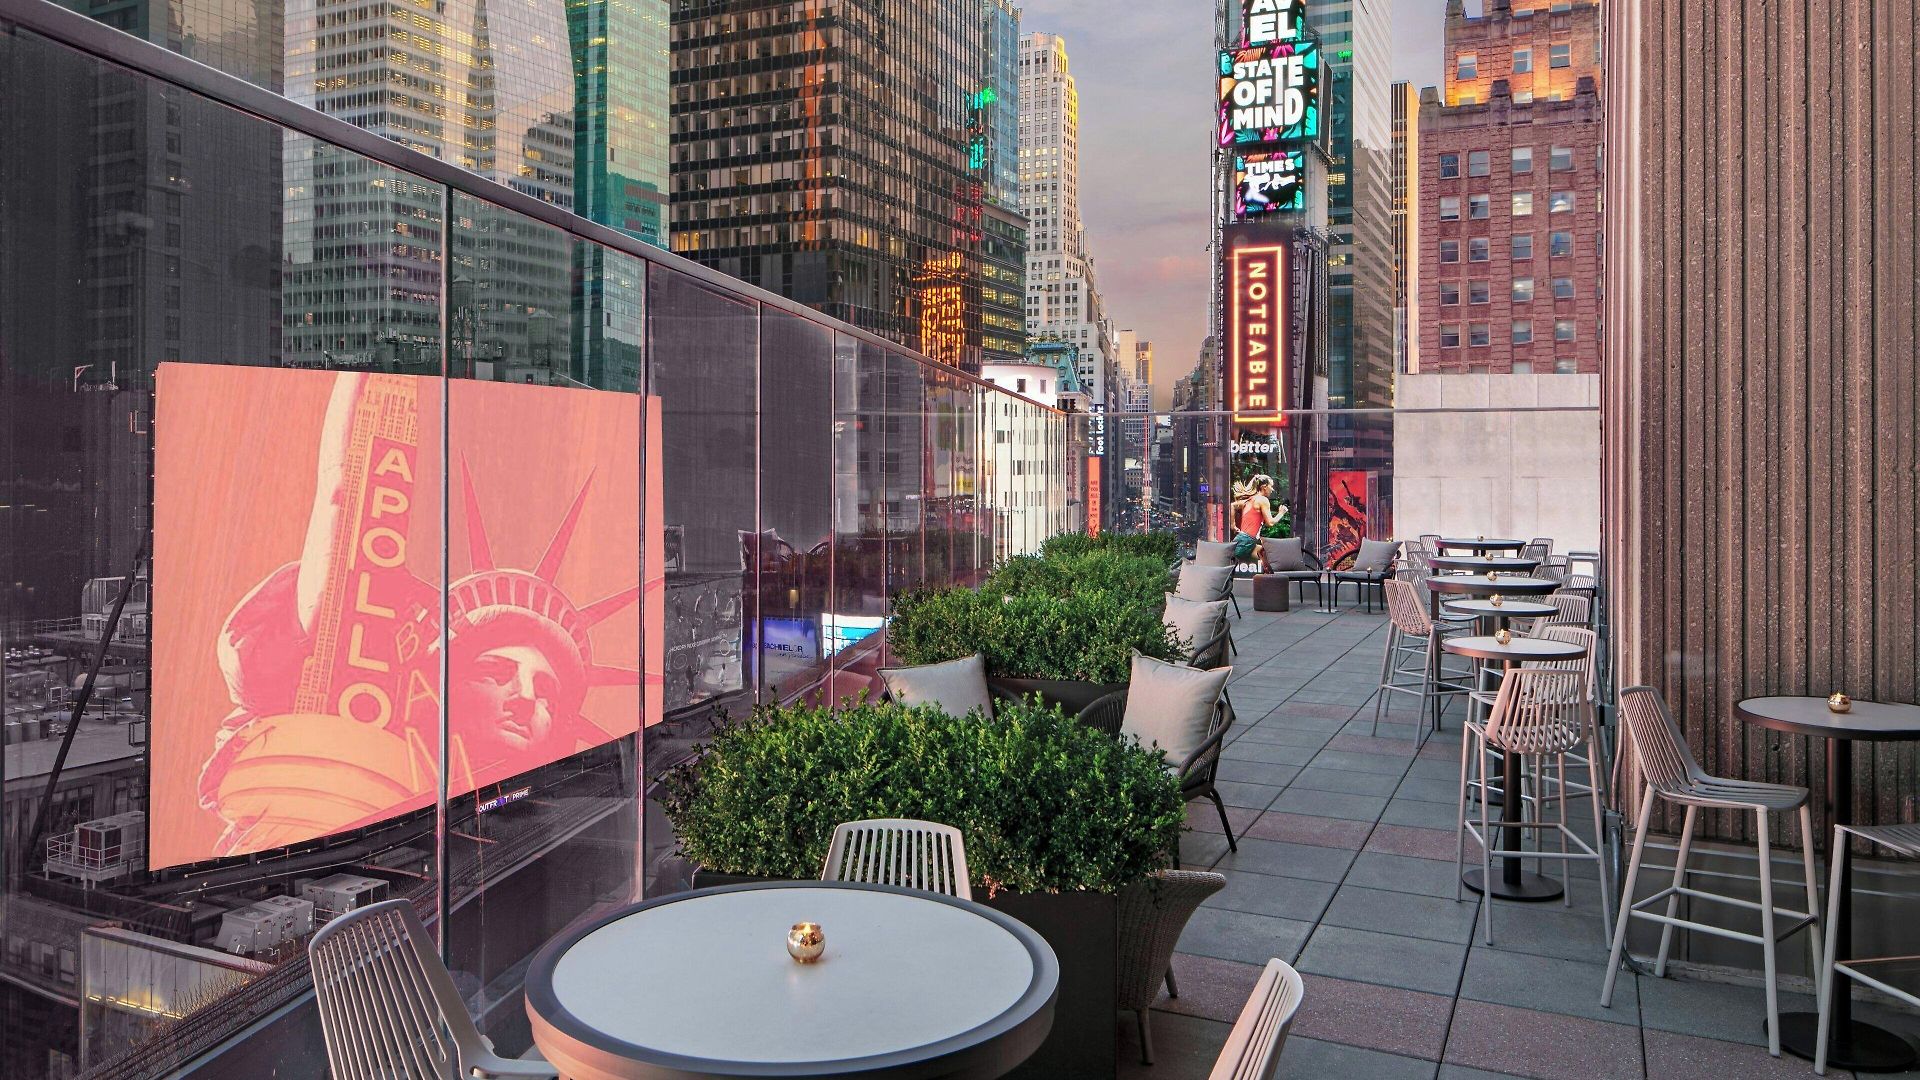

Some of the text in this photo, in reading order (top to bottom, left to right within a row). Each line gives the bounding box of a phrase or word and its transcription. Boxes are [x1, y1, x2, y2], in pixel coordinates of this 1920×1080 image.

[1250, 11, 1297, 43] EL
[1233, 55, 1304, 91] STATE
[1233, 79, 1273, 106] OF
[1233, 88, 1304, 130] MIND
[1244, 158, 1295, 174] TIMES
[1248, 261, 1267, 408] NOTEABLE
[1230, 440, 1277, 453] better
[337, 446, 415, 731] APOLLO
[479, 795, 509, 813] OUTFRT
